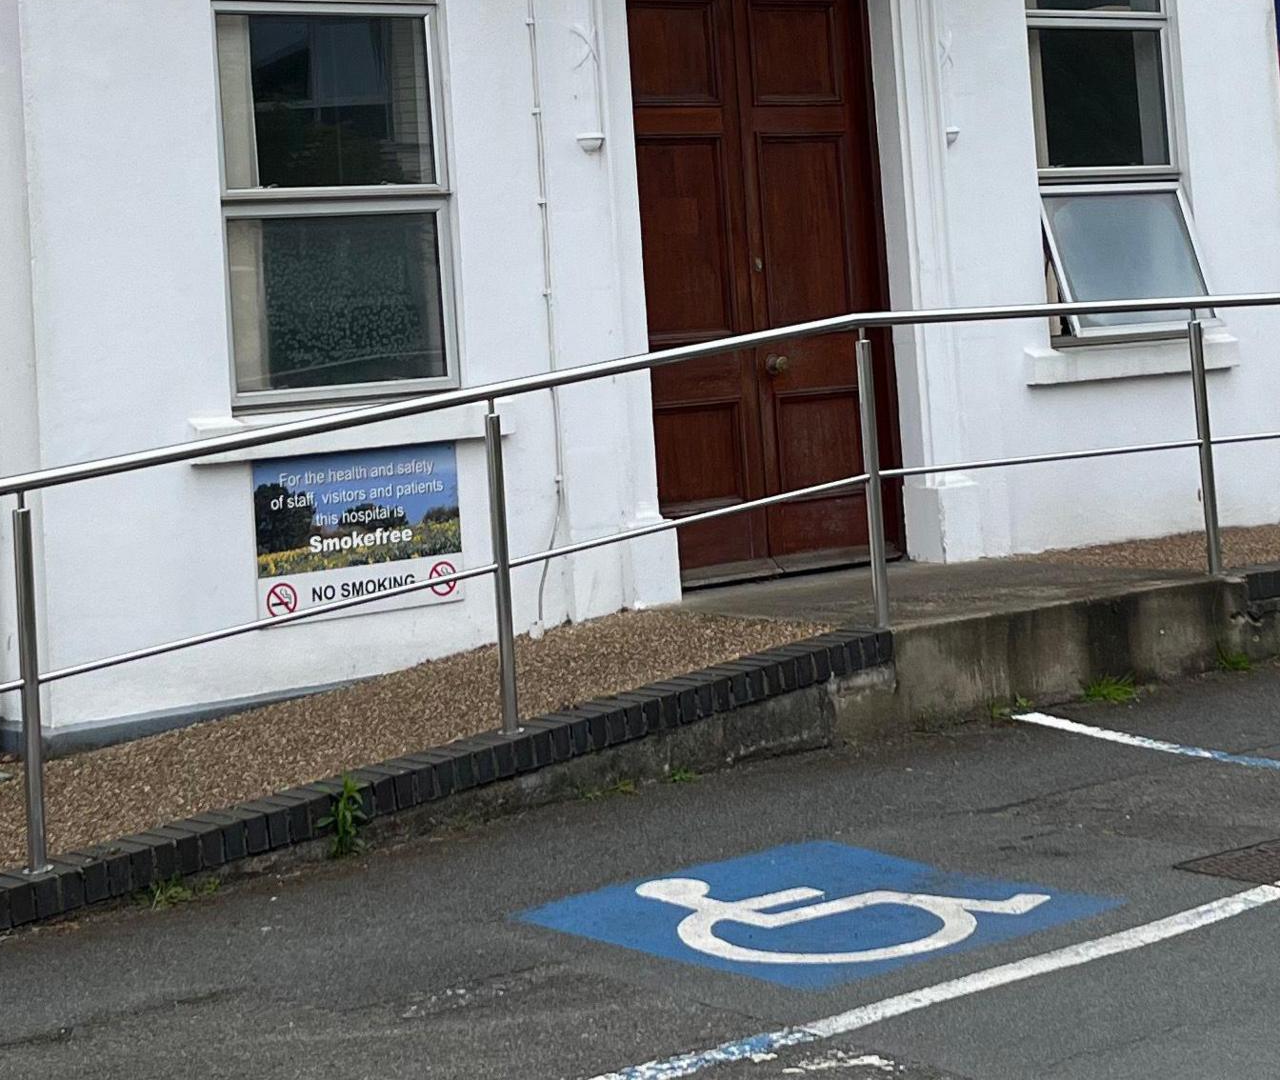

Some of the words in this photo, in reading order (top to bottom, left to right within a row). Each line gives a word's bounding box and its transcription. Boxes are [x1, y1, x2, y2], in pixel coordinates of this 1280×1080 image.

[279, 471, 301, 488] For
[304, 470, 325, 485] the
[328, 466, 368, 484] health
[370, 462, 394, 478] and
[397, 459, 434, 475] safety
[270, 495, 284, 511] of
[287, 491, 318, 508] staff,
[322, 487, 366, 505] visitors
[370, 483, 393, 499] and
[396, 478, 444, 498] patients
[315, 510, 338, 527] this
[342, 505, 391, 525] hospital
[393, 504, 404, 518] is
[309, 526, 413, 553] Smokefree
[312, 584, 336, 602] NO
[340, 573, 416, 598] SMOKING
